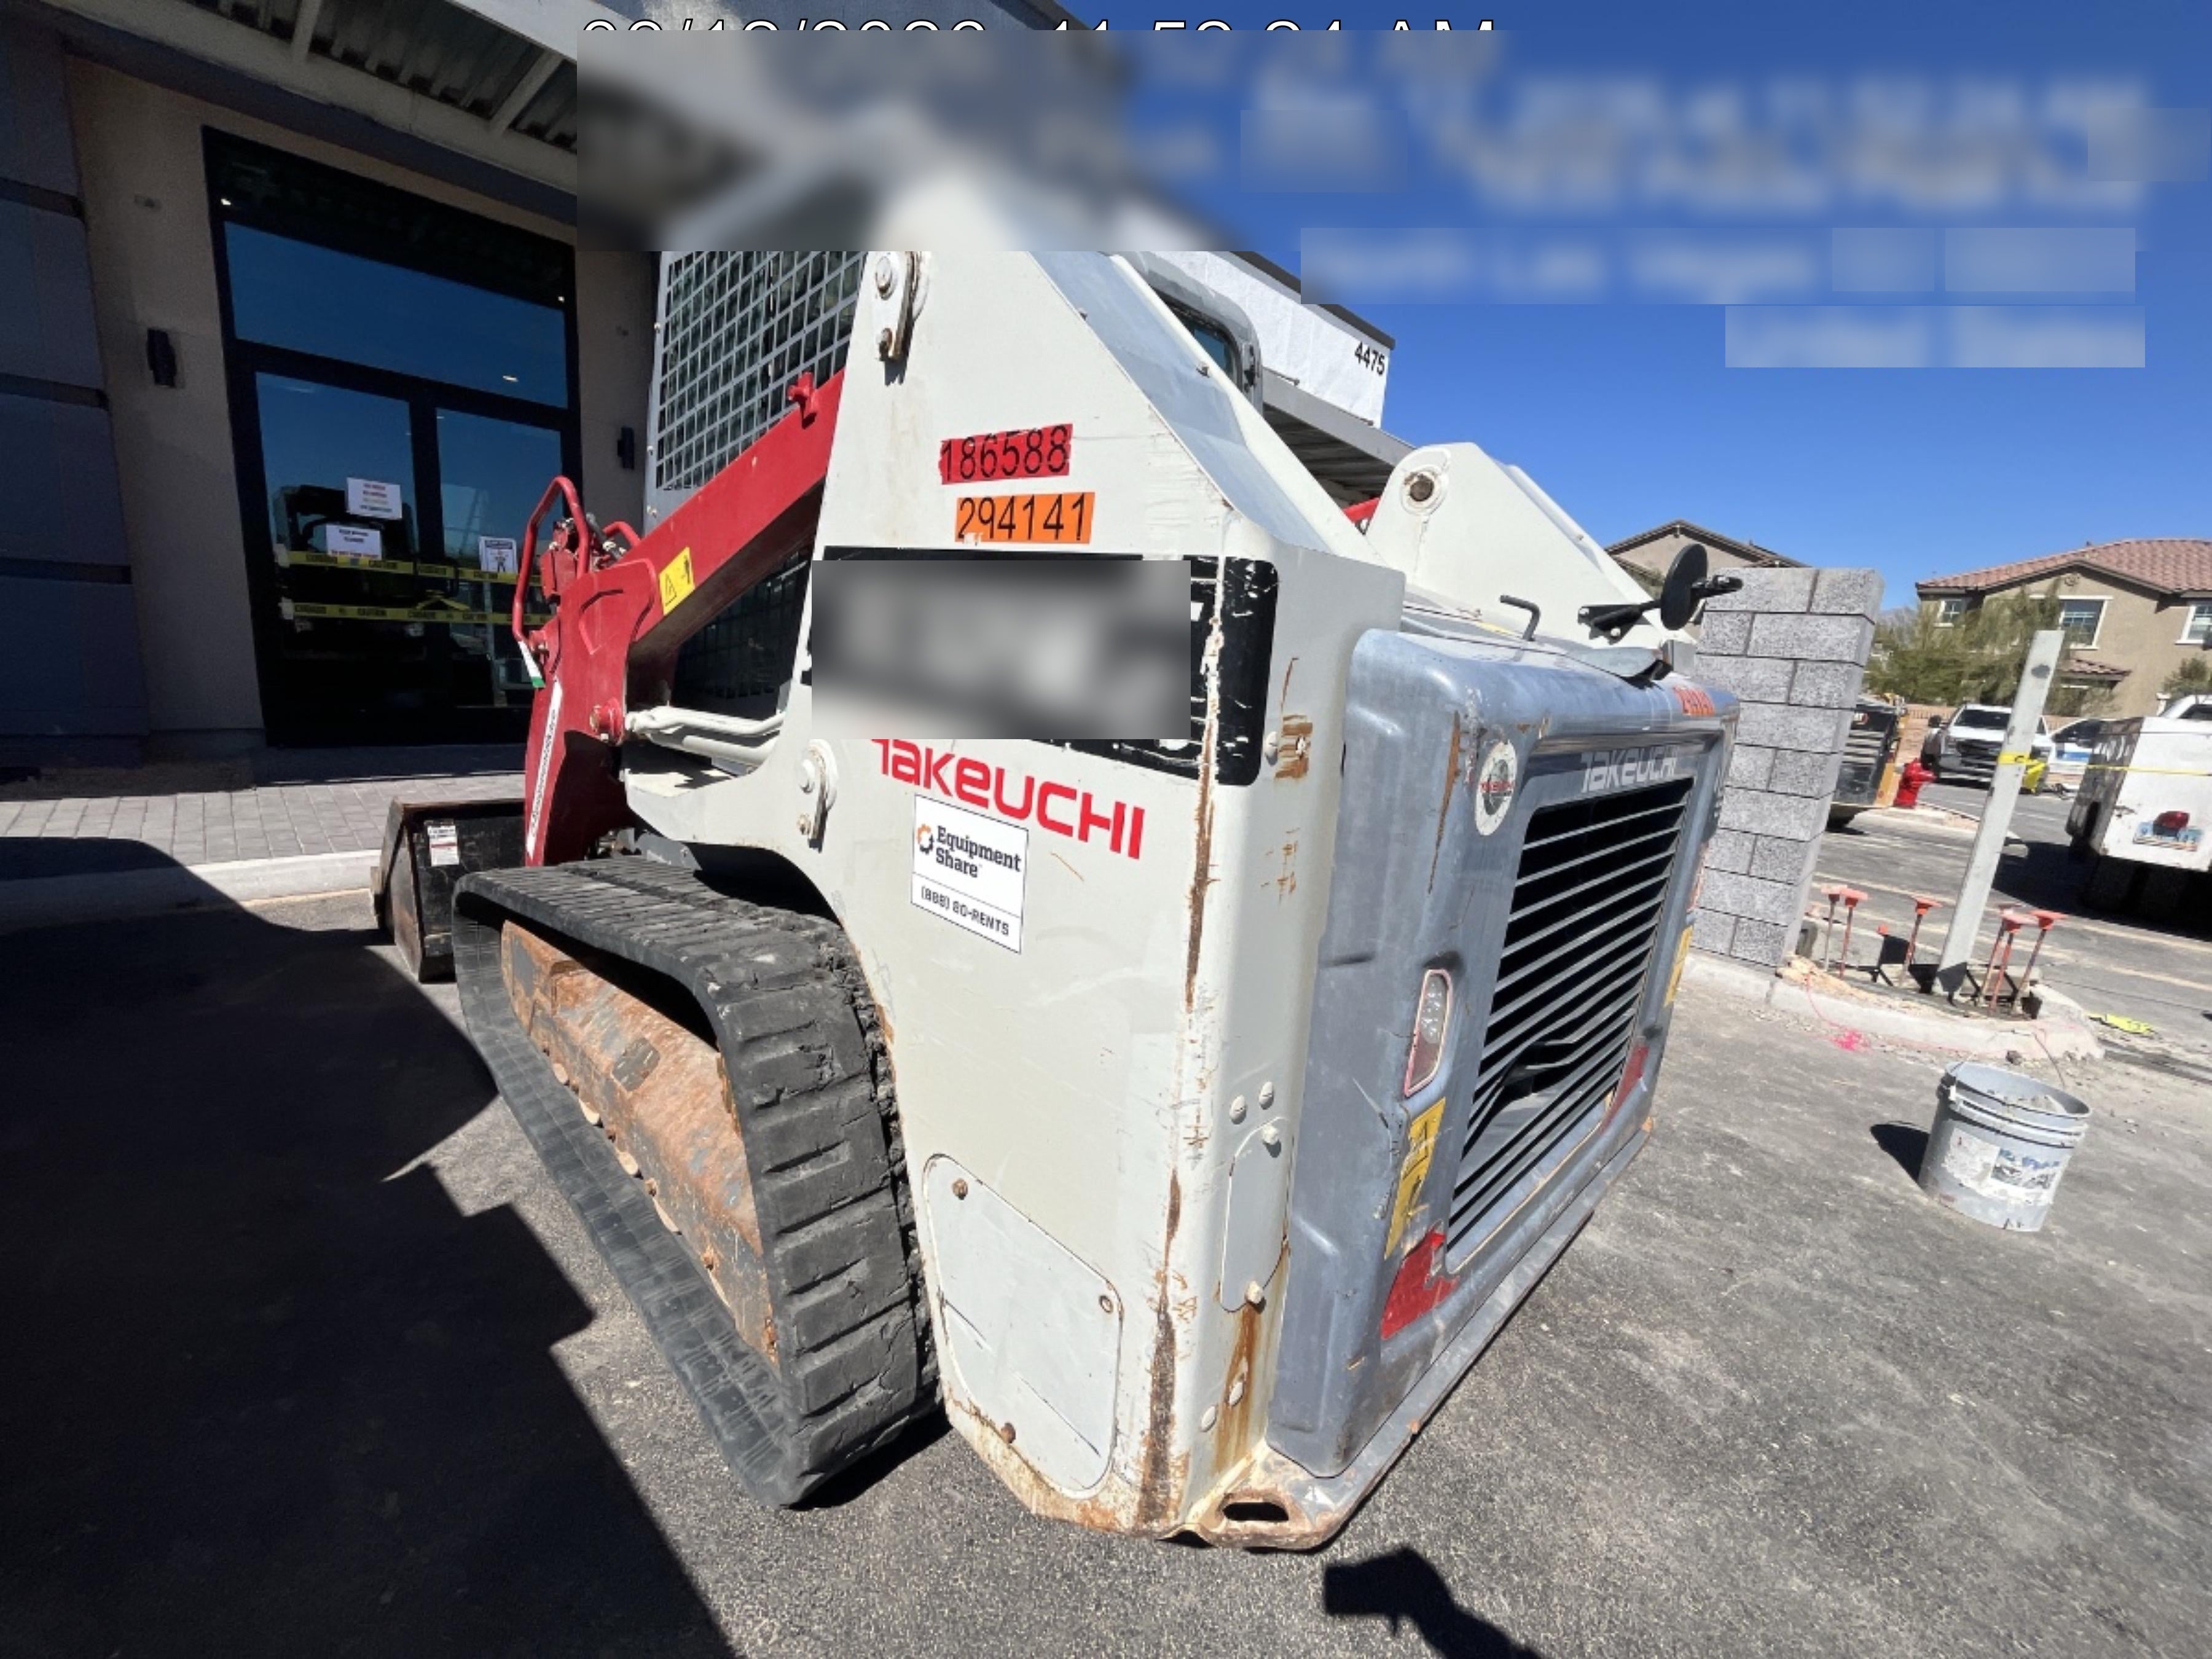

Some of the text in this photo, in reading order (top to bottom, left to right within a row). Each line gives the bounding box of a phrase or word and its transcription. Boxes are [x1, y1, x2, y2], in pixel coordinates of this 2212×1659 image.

[1355, 342, 1385, 376] 4475
[941, 425, 1068, 482] 186588
[958, 492, 1085, 541] 294141
[935, 846, 978, 879] Share
[937, 825, 1021, 872] Equipment
